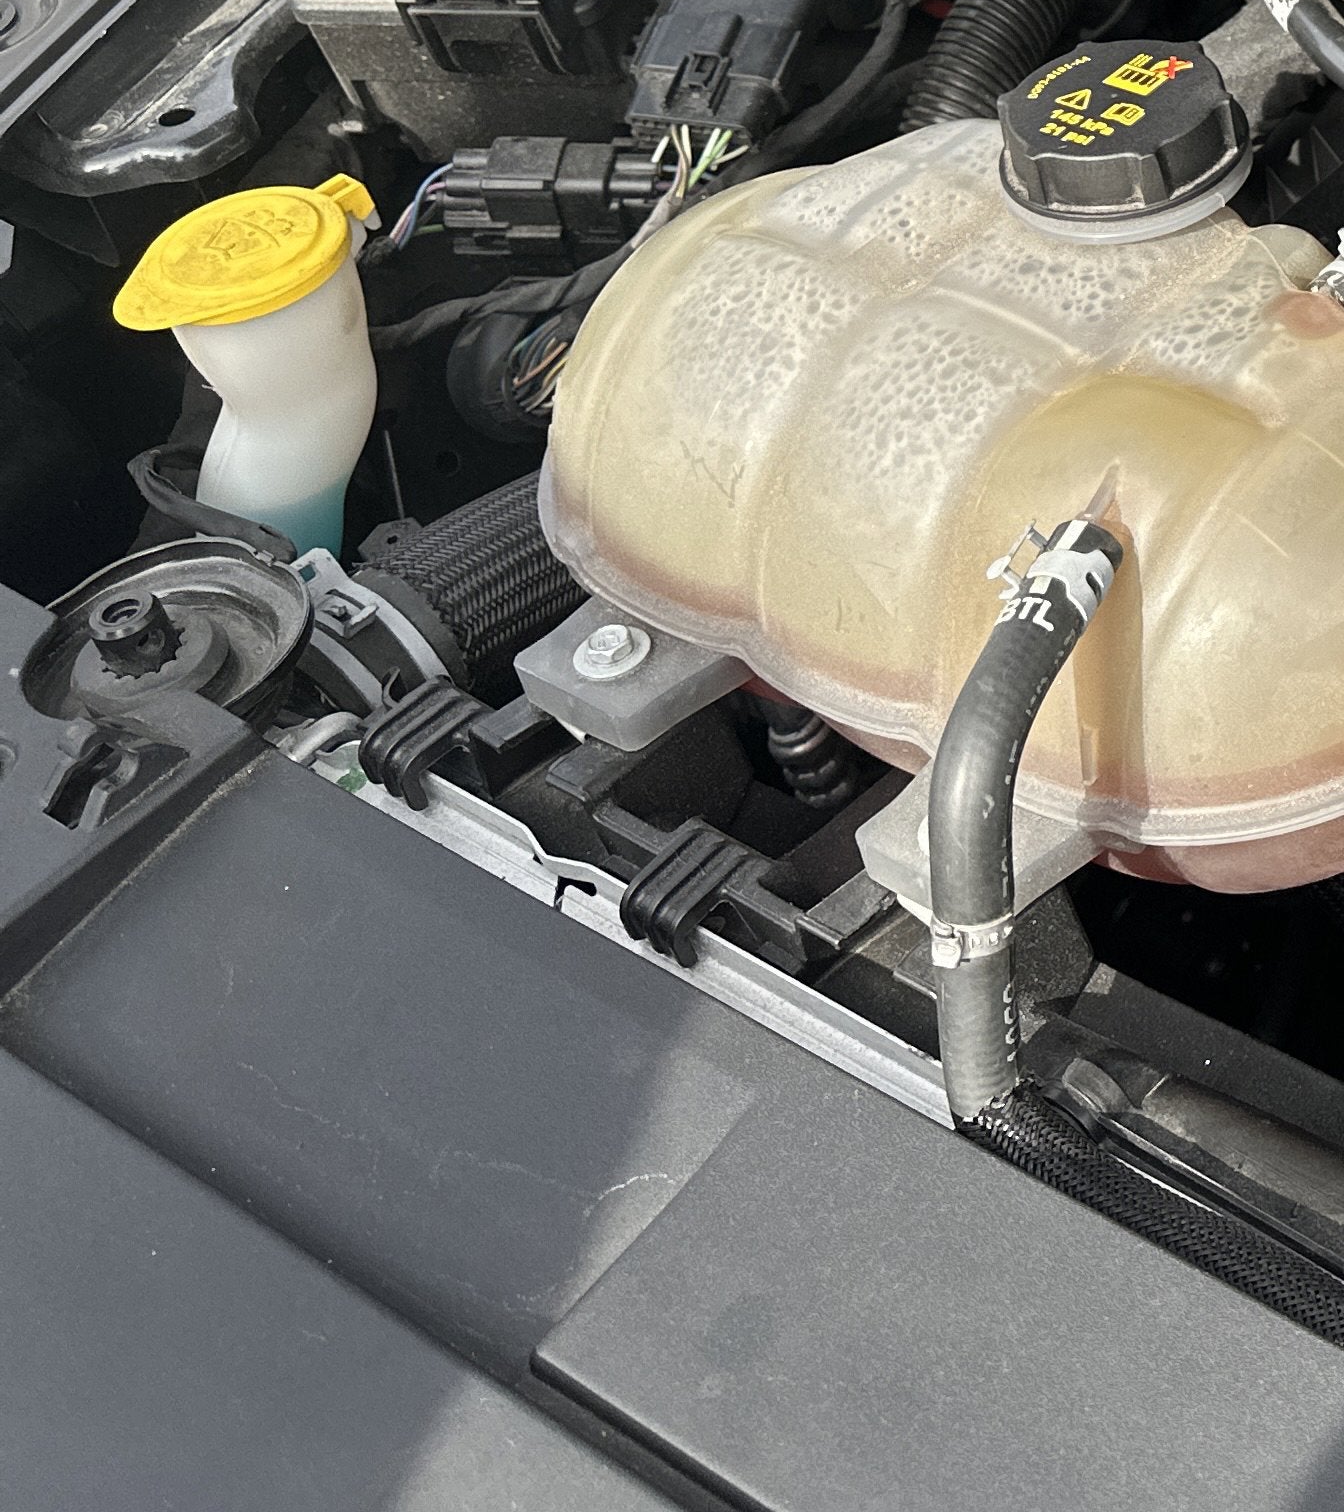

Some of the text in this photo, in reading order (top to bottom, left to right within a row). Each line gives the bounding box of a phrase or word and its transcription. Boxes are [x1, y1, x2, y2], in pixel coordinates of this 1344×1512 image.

[1039, 122, 1096, 146] 21 psi
[1080, 118, 1115, 136] kPa
[993, 593, 1057, 632] BTL
